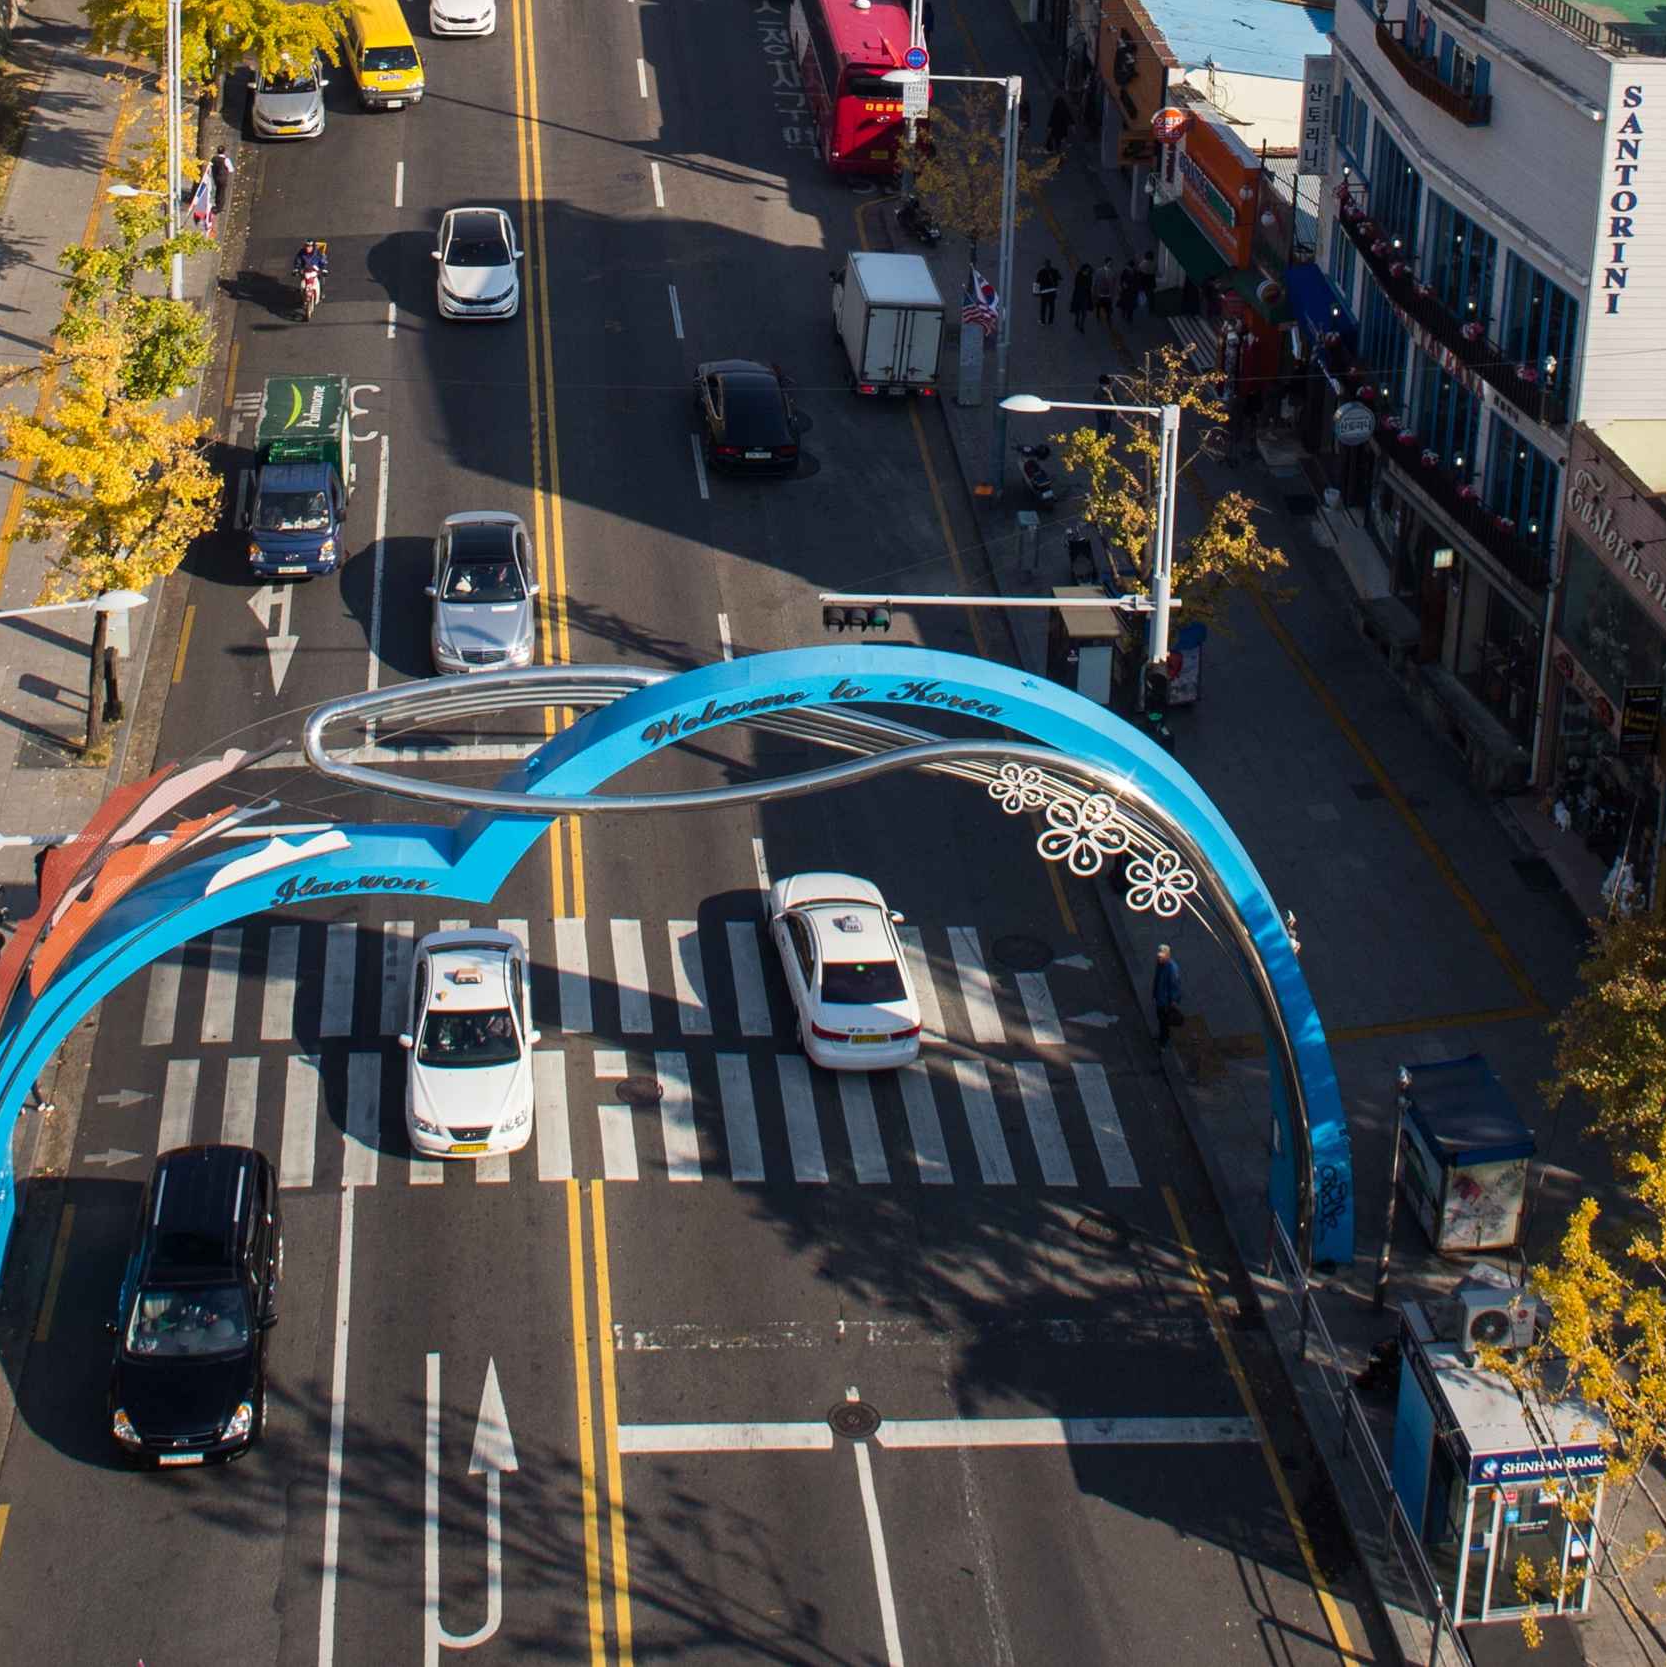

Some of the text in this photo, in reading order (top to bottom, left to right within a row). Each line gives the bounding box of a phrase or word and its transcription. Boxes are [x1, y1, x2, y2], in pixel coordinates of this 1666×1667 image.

[1305, 81, 1327, 171] 산토리니
[1602, 85, 1644, 314] SANTORINI
[297, 383, 326, 428] Pulmuone
[640, 678, 1012, 746] Welcome to Korea
[270, 874, 440, 906] Itaewon
[1500, 1454, 1605, 1475] SHINHAN BANK
